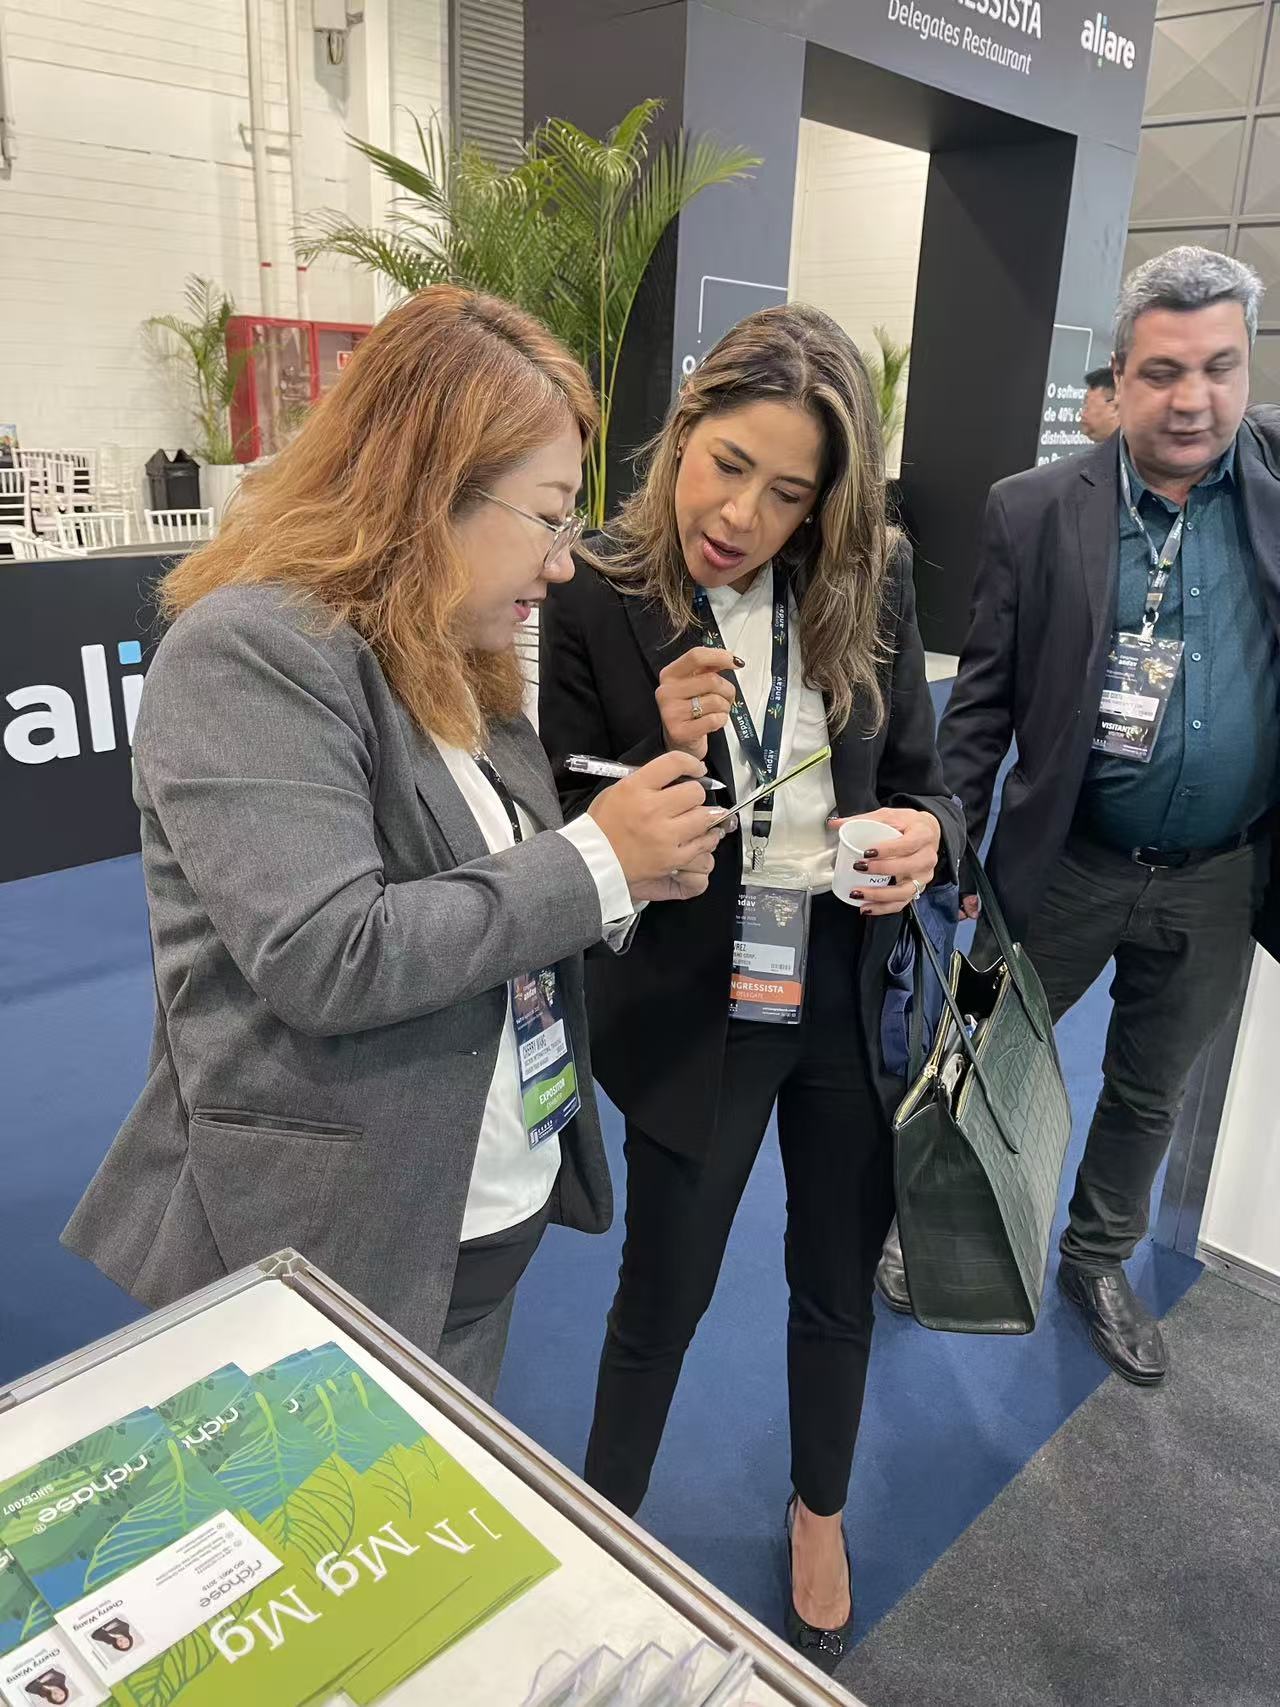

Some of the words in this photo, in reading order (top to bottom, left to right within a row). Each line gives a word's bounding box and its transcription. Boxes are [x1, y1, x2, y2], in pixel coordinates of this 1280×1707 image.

[958, 0, 1041, 38] SSISTA
[888, 0, 960, 46] Delegates
[962, 27, 1032, 75] Restaurant
[1081, 12, 1136, 70] aliare
[1047, 382, 1056, 398] O
[1057, 384, 1088, 399] softwar
[1044, 406, 1056, 422] de
[736, 715, 750, 740] andav
[181, 1407, 239, 1449] rich
[315, 1520, 421, 1596] Mg
[98, 1600, 124, 1617] Cherry
[73, 1616, 98, 1631] Wang
[209, 1584, 323, 1665] Mg
[33, 1648, 60, 1667] Cherry
[6, 1667, 33, 1683] Wang
